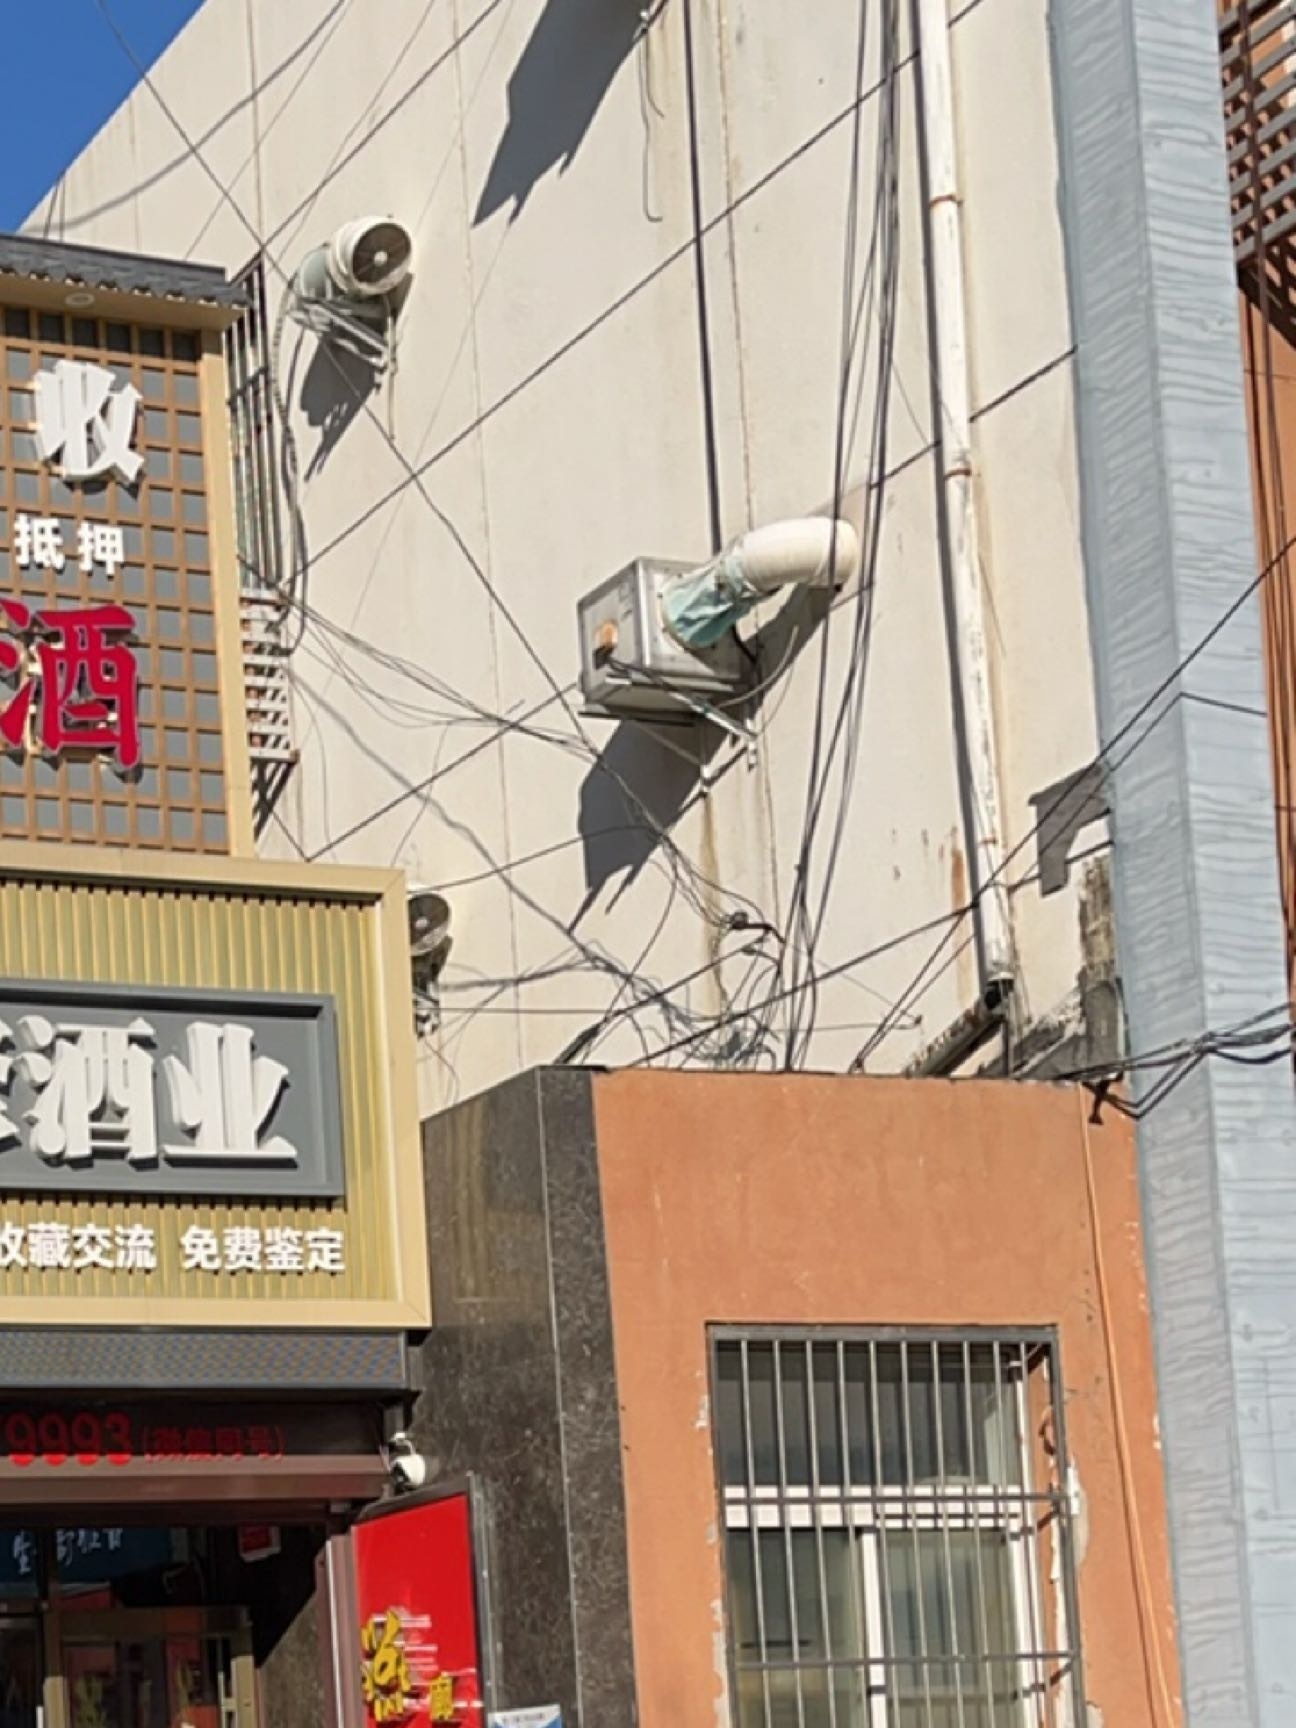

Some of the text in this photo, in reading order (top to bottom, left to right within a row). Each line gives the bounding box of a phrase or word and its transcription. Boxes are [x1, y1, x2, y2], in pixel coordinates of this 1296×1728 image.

[12, 512, 127, 577] 抵押
[179, 1222, 347, 1275] 免费鉴定
